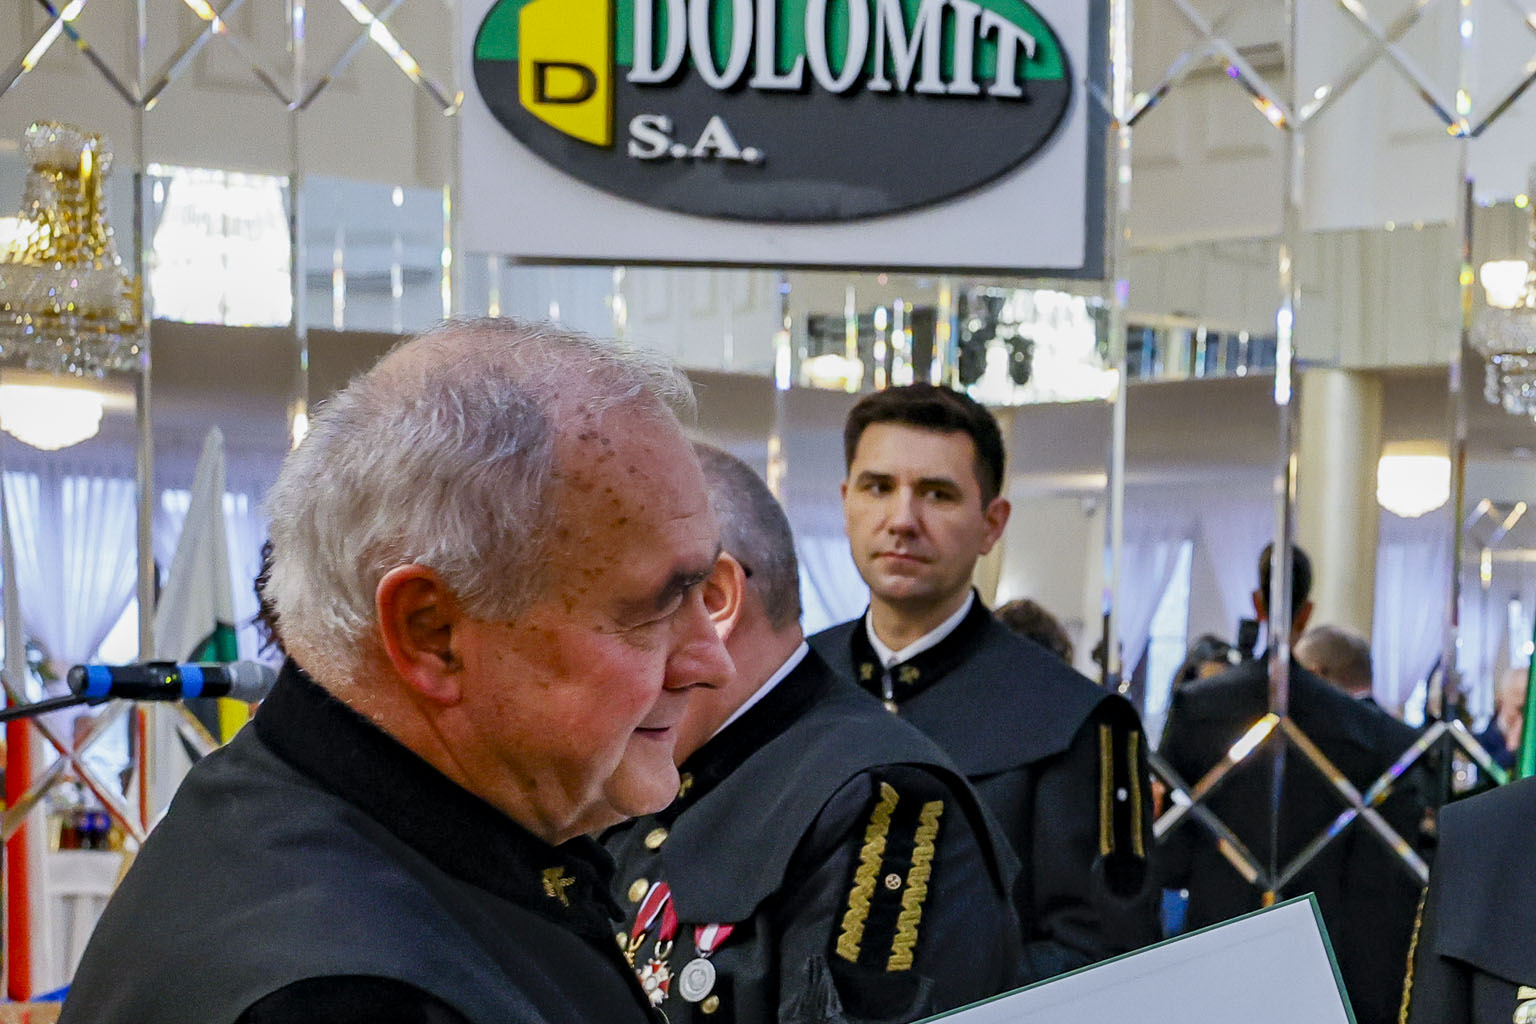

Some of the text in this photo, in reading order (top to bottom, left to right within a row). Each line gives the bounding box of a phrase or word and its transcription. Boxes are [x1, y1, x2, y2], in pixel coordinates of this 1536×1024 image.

[627, 0, 1036, 97] DOLOMIT
[533, 61, 597, 104] D
[628, 114, 764, 162] S.A.
